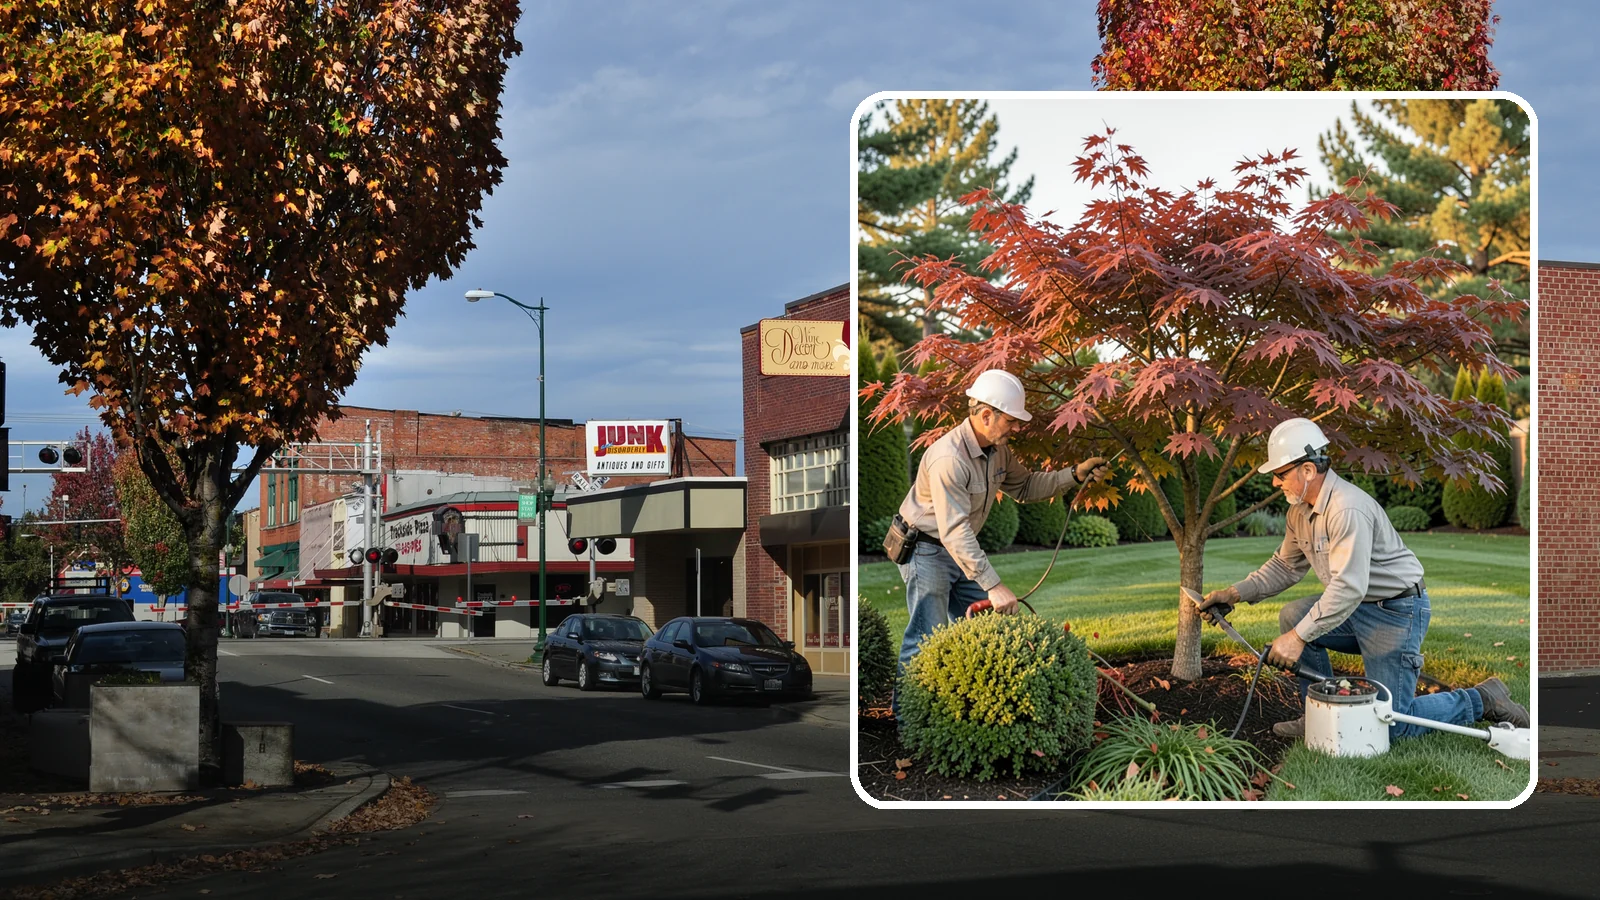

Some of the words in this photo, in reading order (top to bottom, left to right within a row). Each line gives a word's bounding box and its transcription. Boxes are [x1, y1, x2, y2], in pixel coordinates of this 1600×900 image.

[596, 425, 665, 457] JUNK
[607, 446, 646, 454] DISORDERLY
[597, 461, 628, 470] ANTIQUES
[631, 461, 644, 470] AND
[647, 460, 665, 469] GIFTS
[573, 473, 588, 492] RAIL
[415, 519, 429, 534] Pizza
